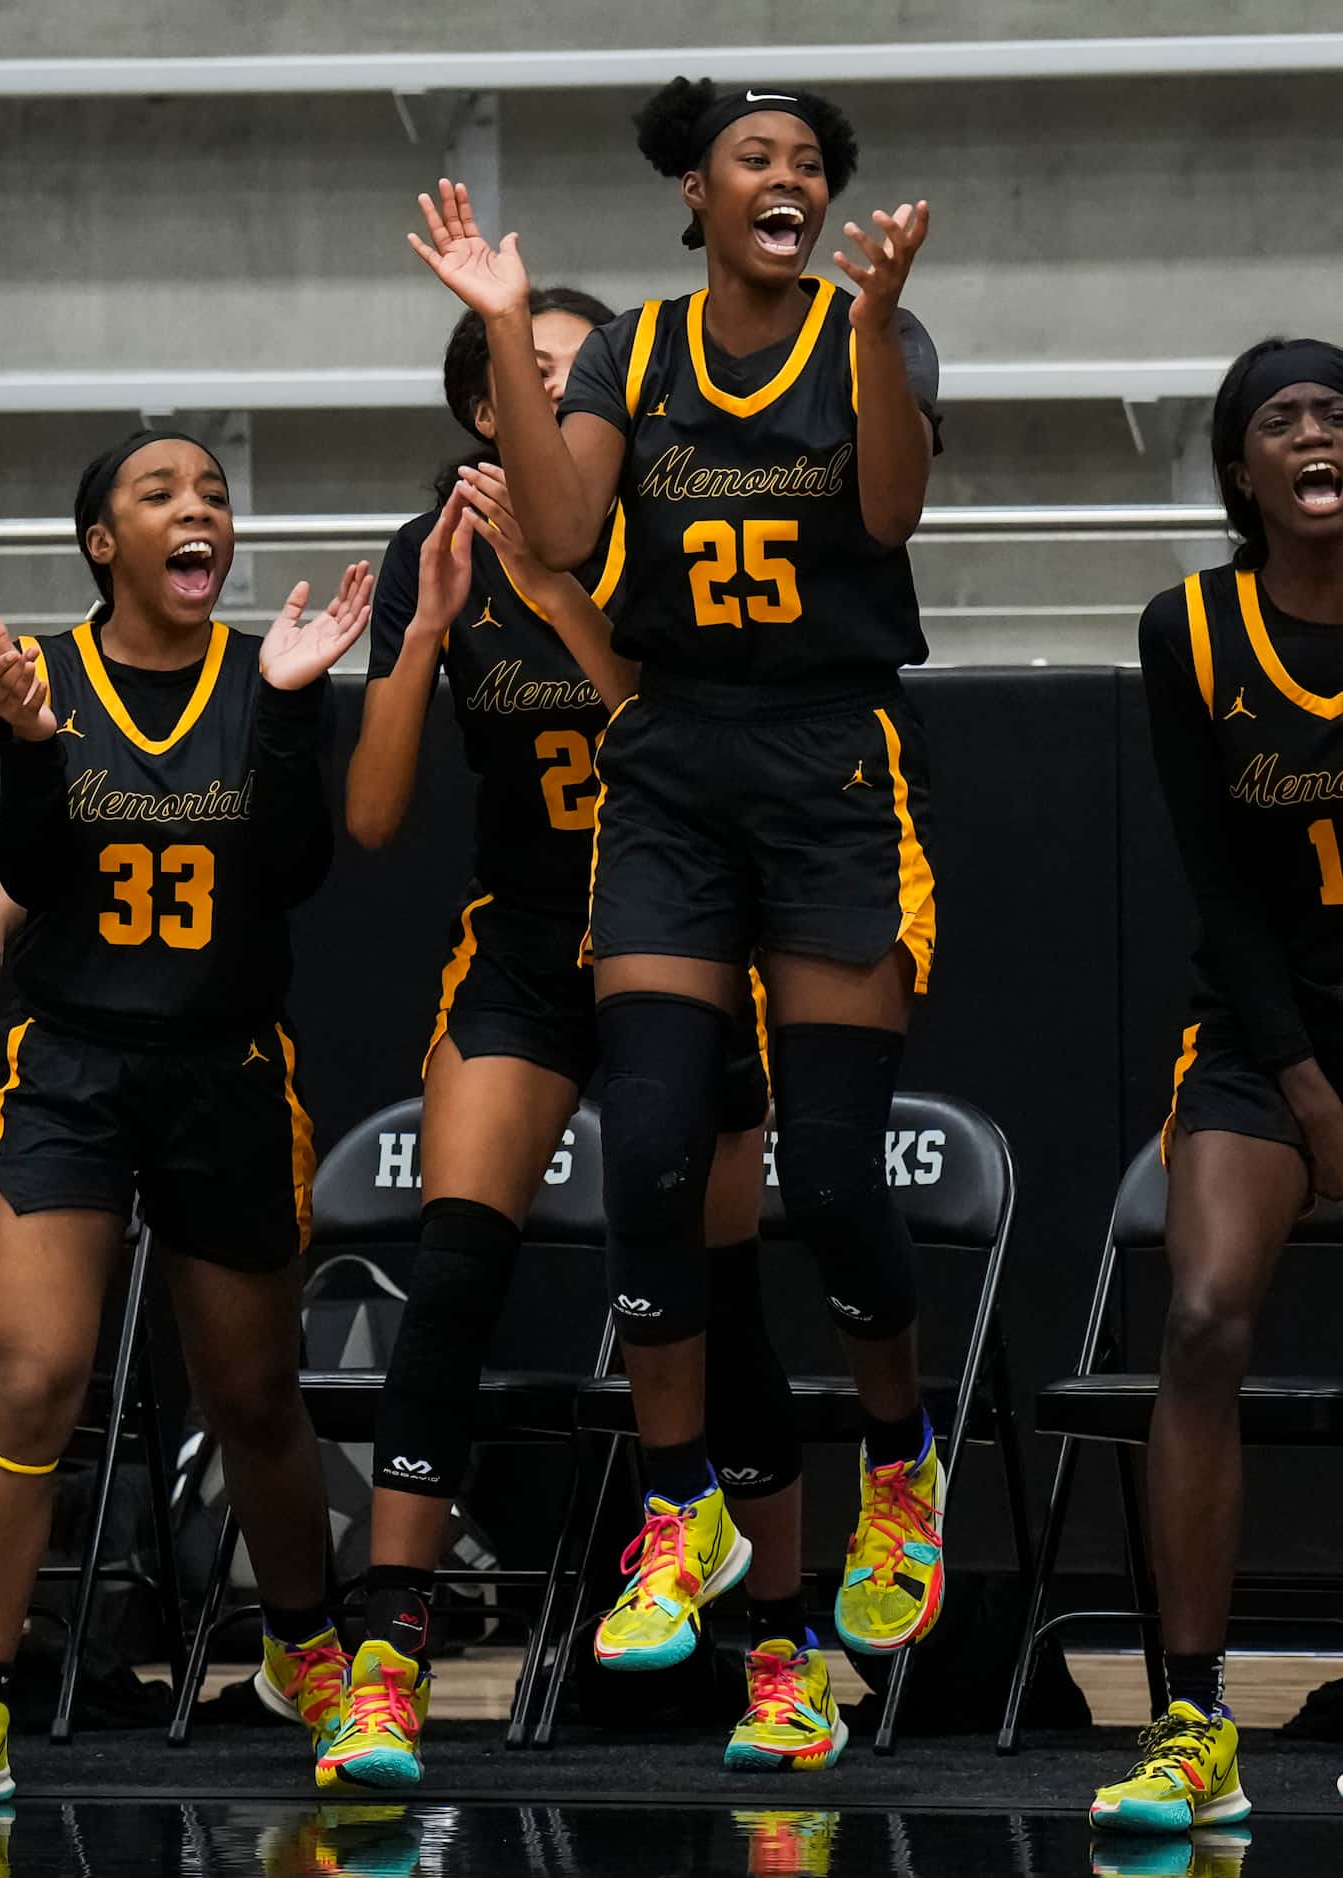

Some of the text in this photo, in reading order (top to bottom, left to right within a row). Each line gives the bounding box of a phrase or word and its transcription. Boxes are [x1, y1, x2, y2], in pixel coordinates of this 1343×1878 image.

[638, 442, 853, 501] Memorial
[683, 519, 802, 628] 25
[466, 659, 602, 714] Memo
[534, 730, 606, 831] 2
[99, 843, 215, 950] 33
